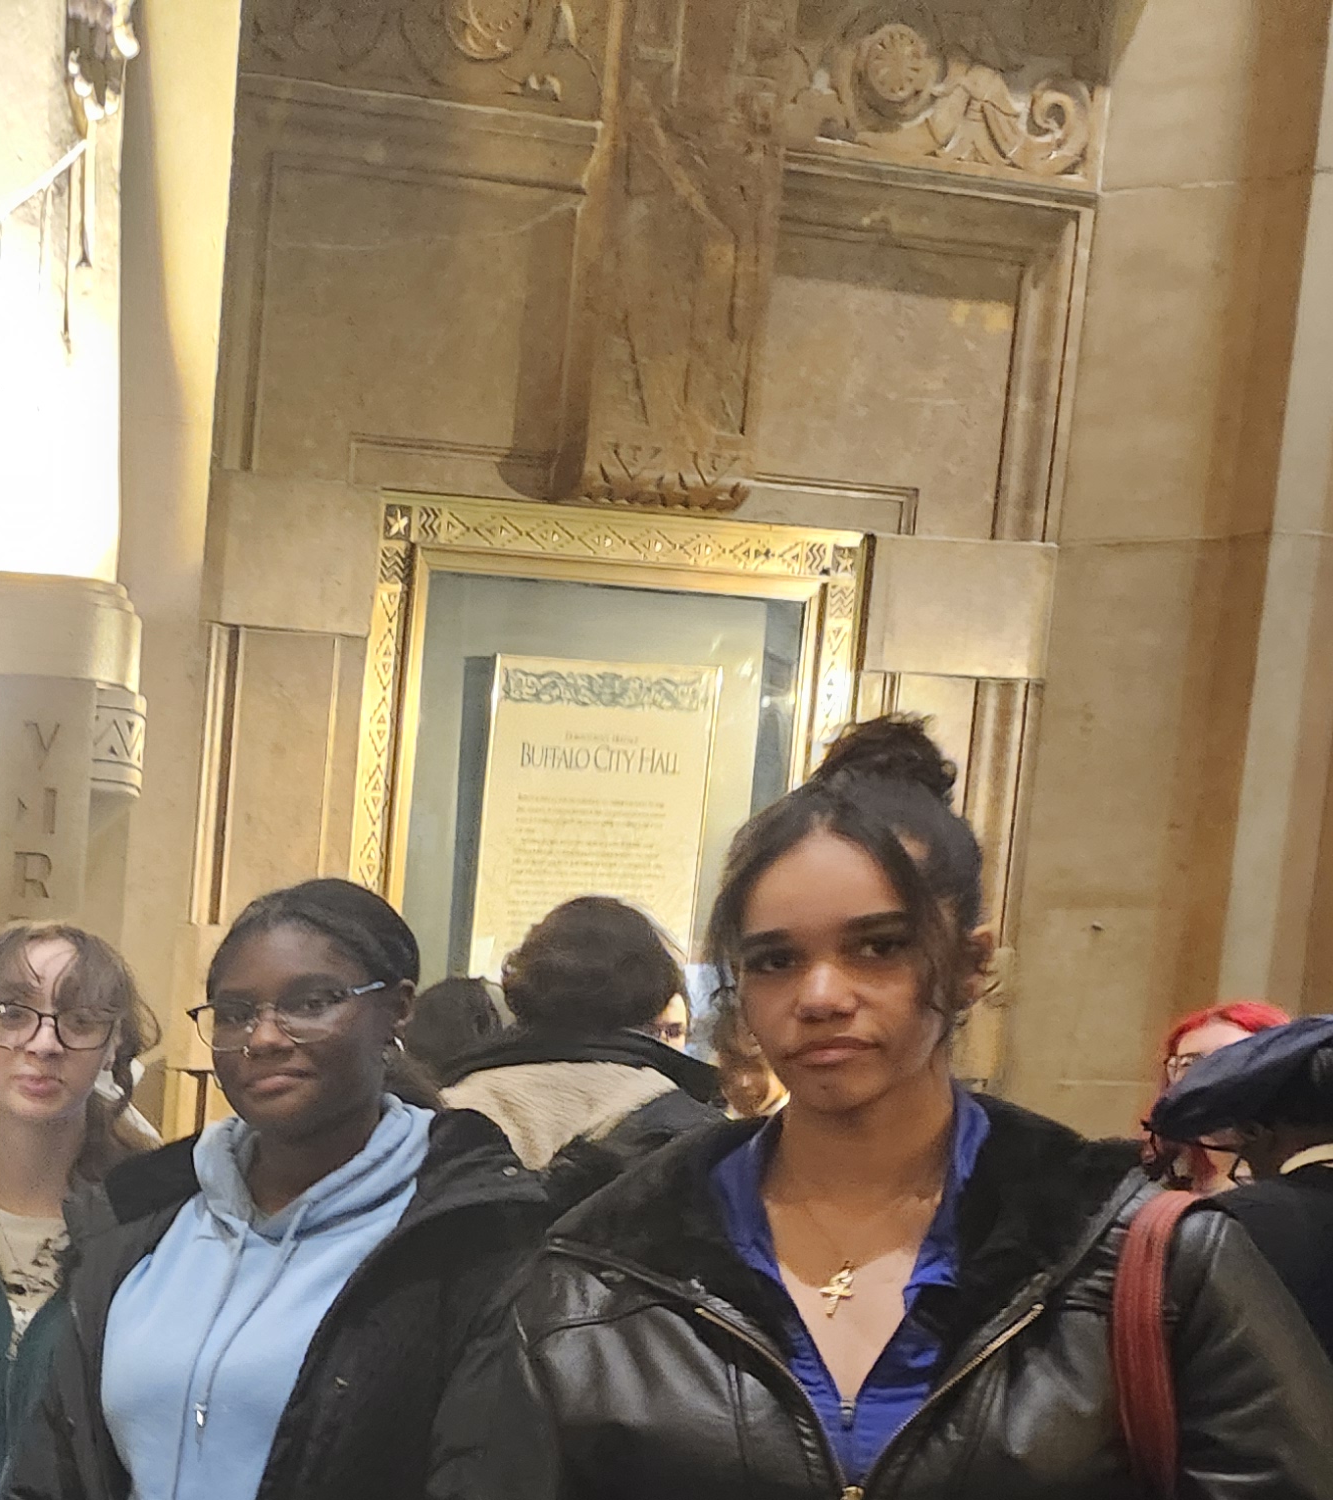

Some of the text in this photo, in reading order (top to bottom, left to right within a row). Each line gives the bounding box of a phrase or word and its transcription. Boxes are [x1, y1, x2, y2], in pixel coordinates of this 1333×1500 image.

[519, 741, 681, 776] BUFFALO CITY HALL
